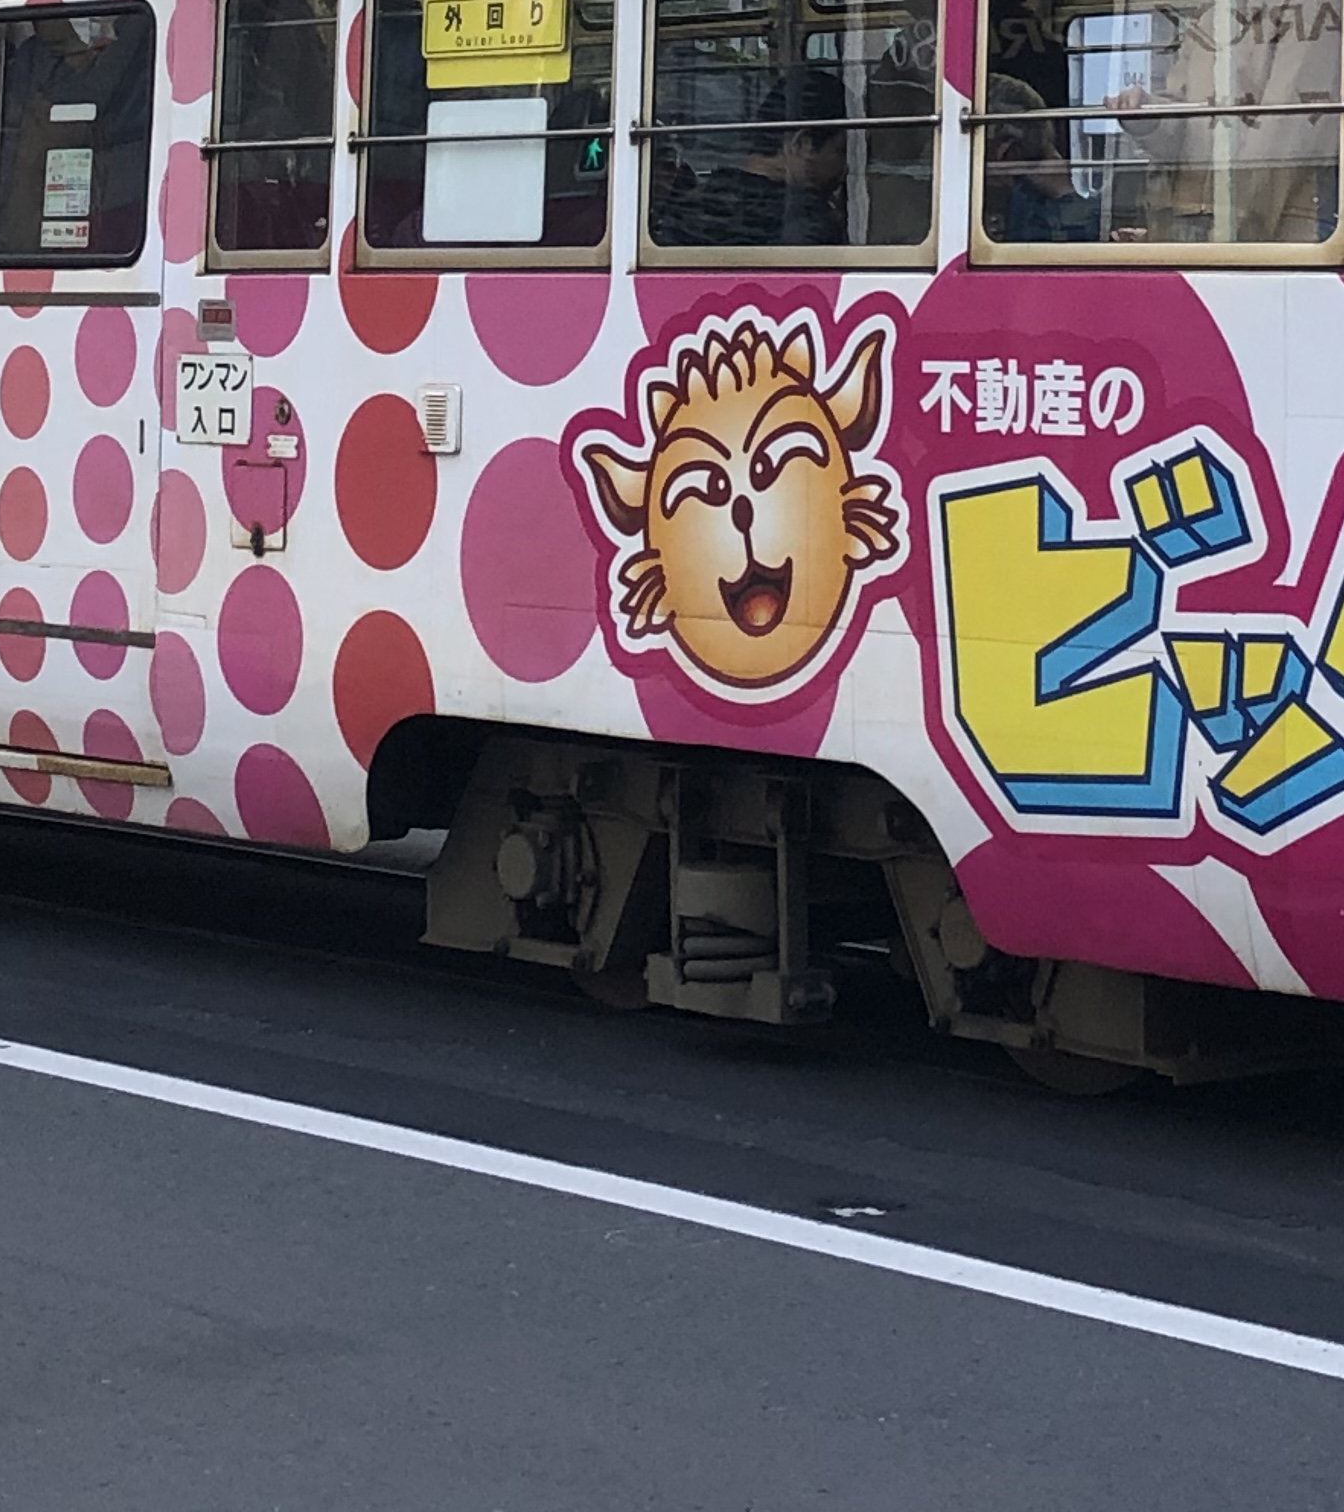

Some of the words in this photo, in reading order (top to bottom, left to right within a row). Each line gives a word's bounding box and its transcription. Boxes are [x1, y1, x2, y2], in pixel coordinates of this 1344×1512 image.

[444, 0, 544, 32] 外回り
[455, 35, 493, 48] Outer
[501, 33, 534, 46] Loop
[181, 362, 248, 392] ワンマン
[919, 357, 1145, 436] 不動産の
[191, 405, 236, 435] 入口
